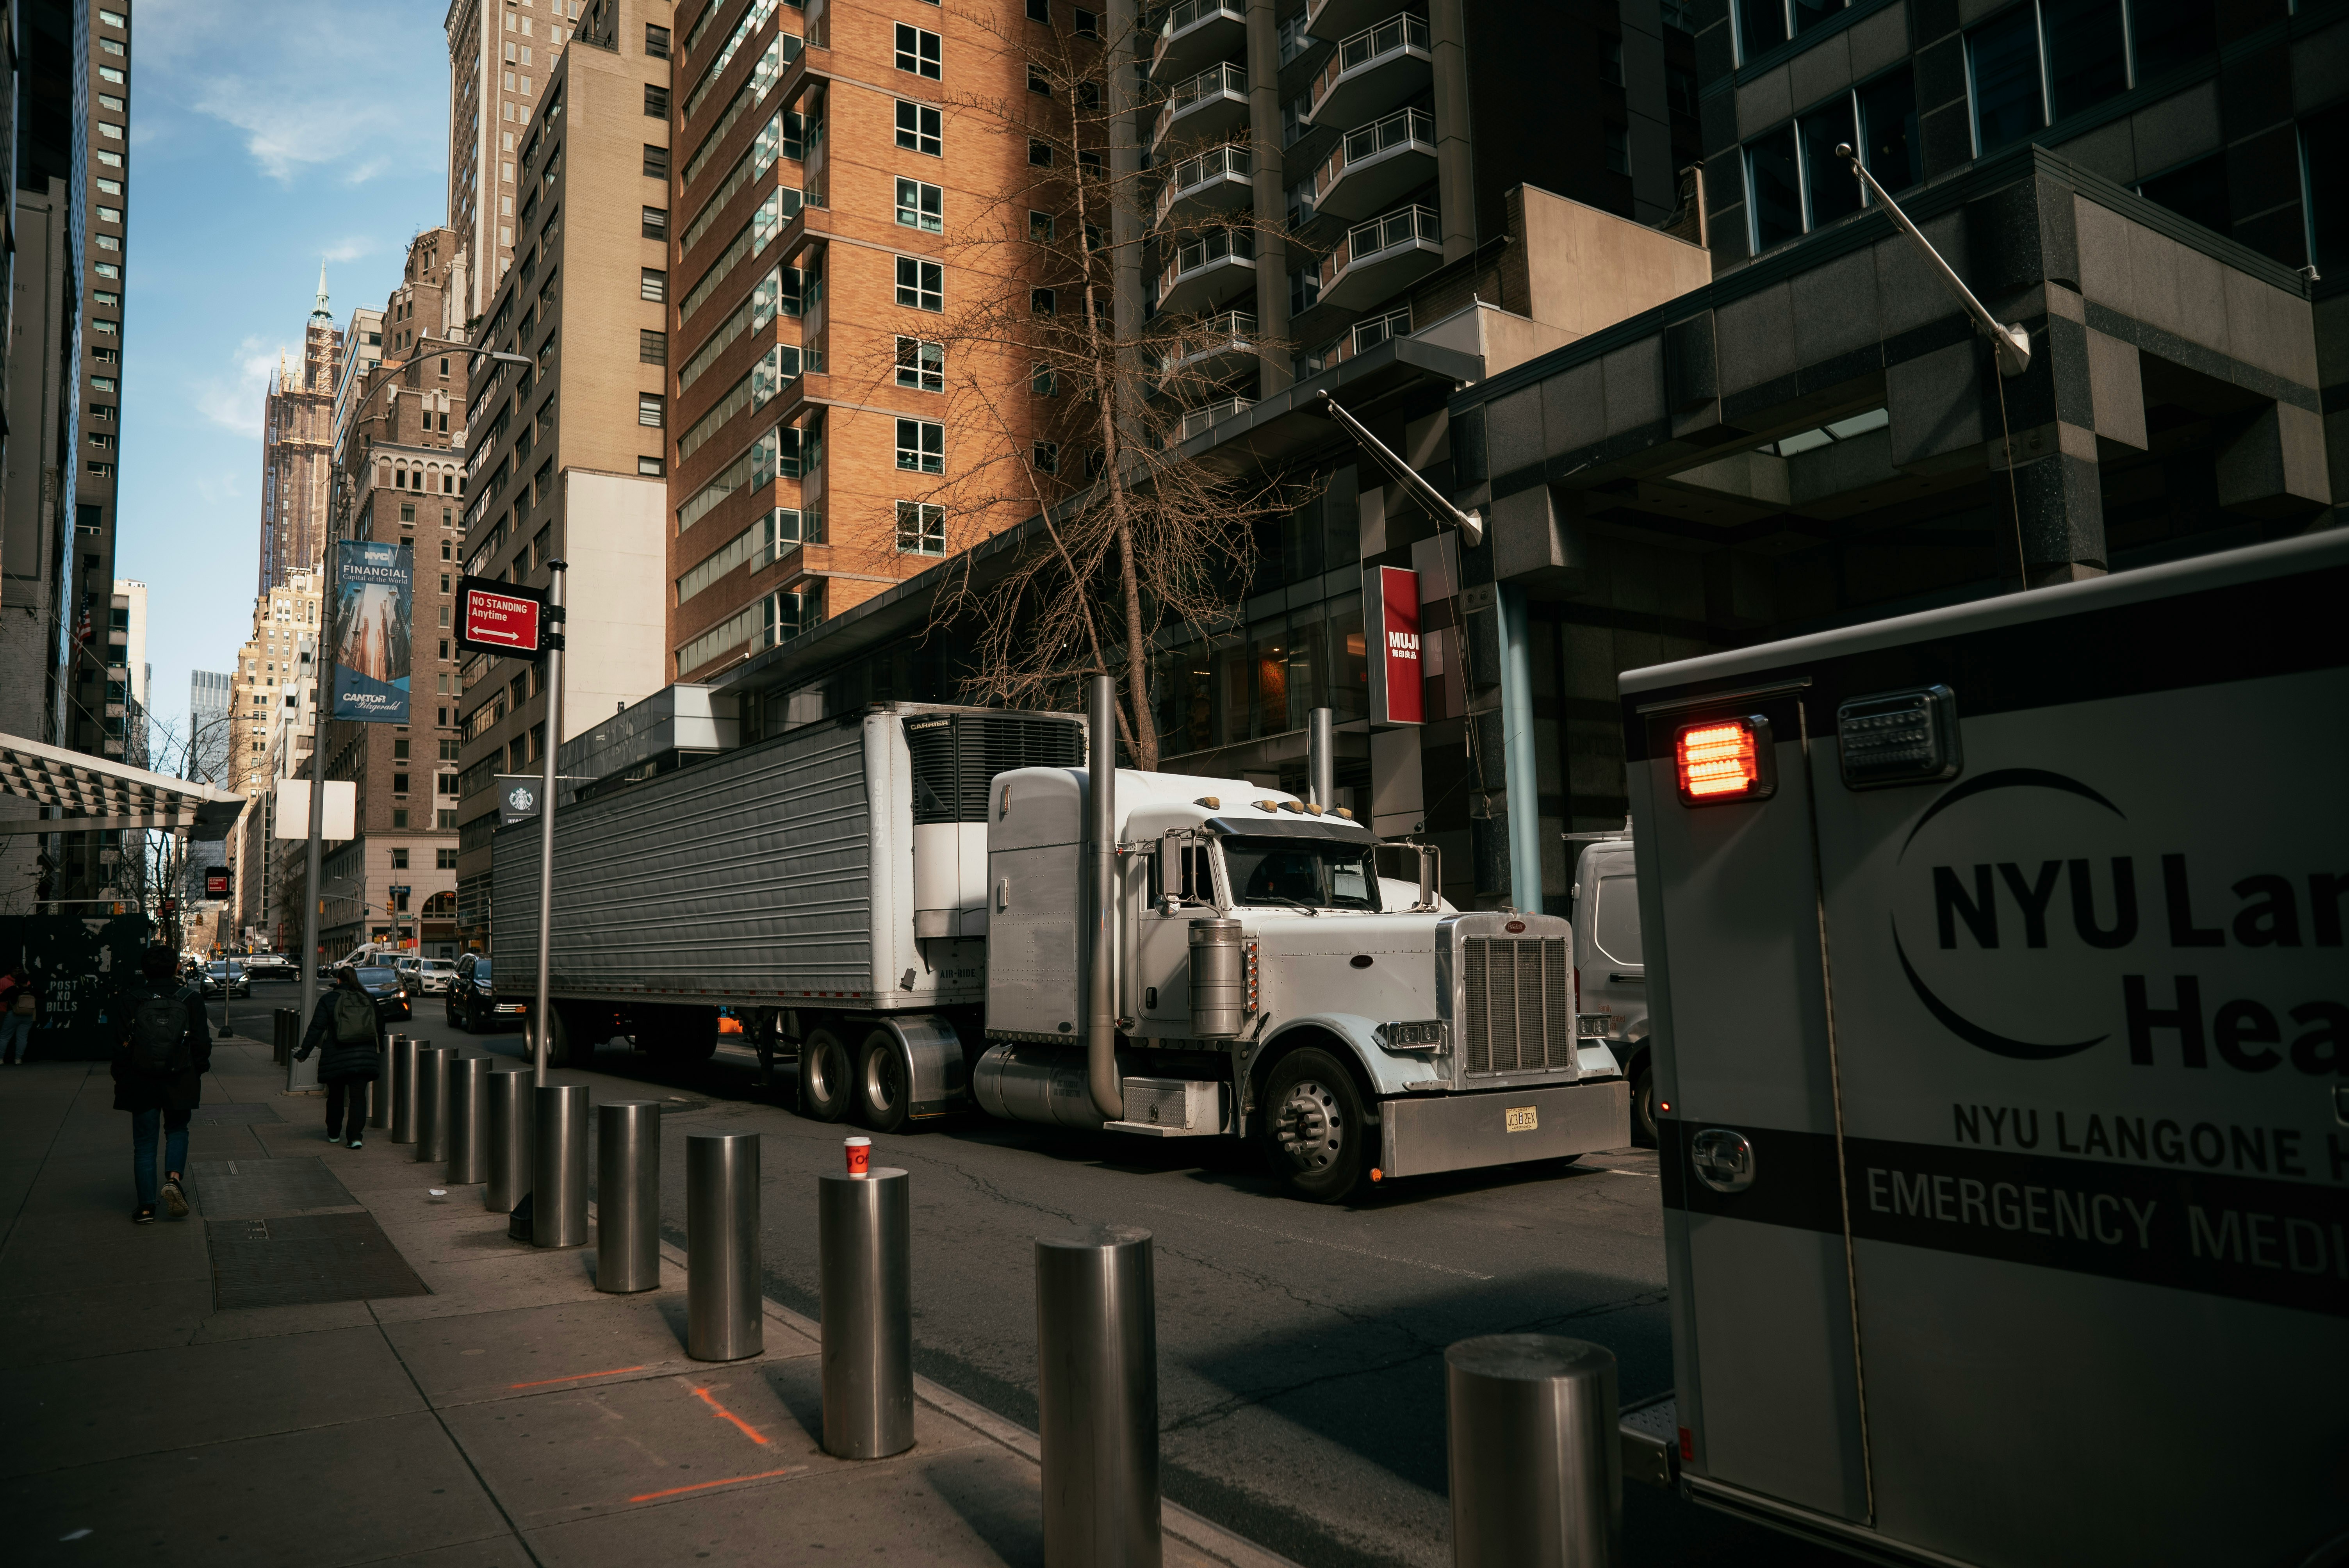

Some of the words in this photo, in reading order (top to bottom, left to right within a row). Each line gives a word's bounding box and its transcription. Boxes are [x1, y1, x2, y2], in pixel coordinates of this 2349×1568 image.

[364, 551, 389, 561] NYC
[343, 565, 408, 578] FINANCIAL
[472, 596, 484, 606] NO
[486, 599, 527, 614] STANDING
[472, 607, 508, 622] Anytime
[1389, 631, 1419, 650] MUJI
[1392, 649, 1417, 659] 無印良品
[343, 693, 386, 703] CANTOR
[910, 720, 948, 731] CARRIER
[1933, 856, 2139, 950] NYU
[940, 969, 975, 978] AIR-RIDE
[50, 980, 78, 991] POST
[57, 991, 70, 1001] NO
[46, 1001, 78, 1012] BILLS
[1598, 1004, 1612, 1014] Family
[1953, 1103, 2039, 1149] NYU
[2055, 1112, 2306, 1177] LANGONE
[1866, 1167, 2158, 1249] EMERGENCY
